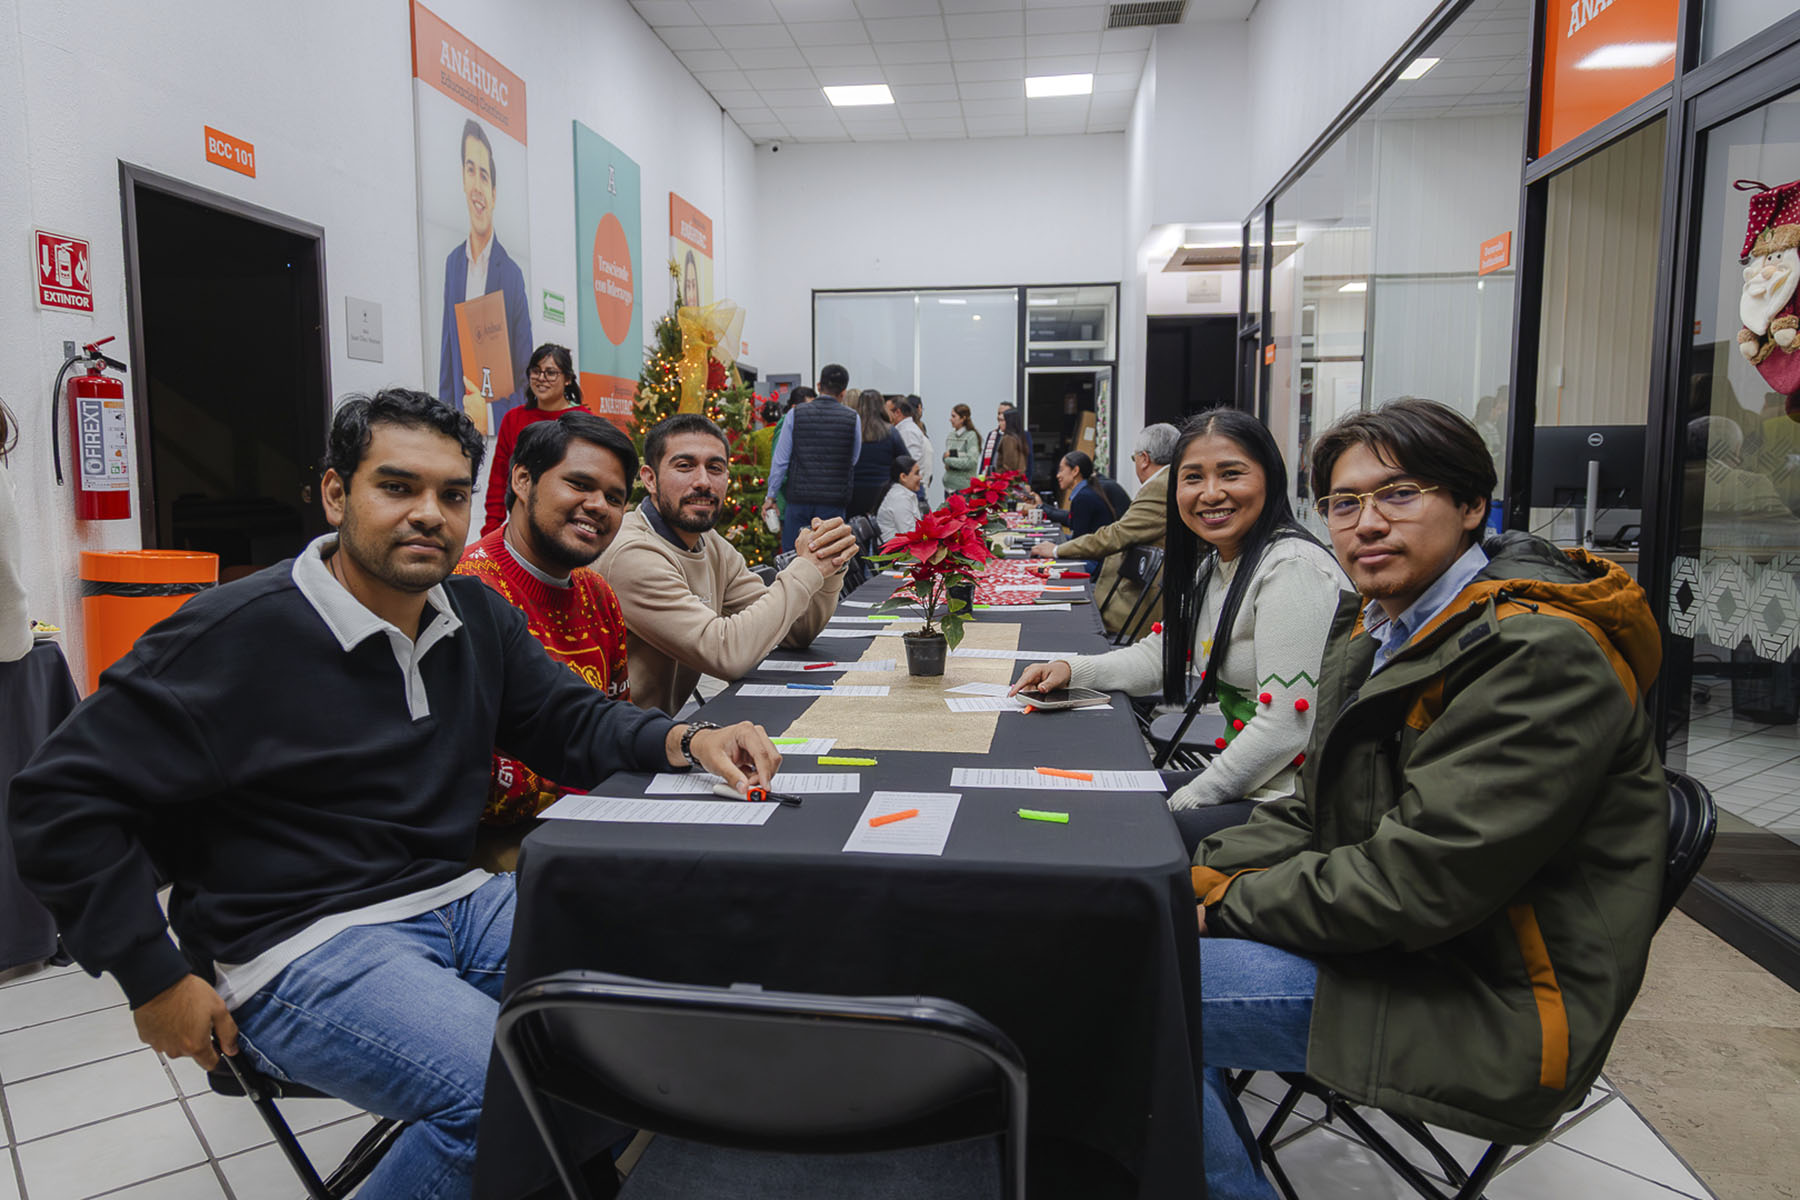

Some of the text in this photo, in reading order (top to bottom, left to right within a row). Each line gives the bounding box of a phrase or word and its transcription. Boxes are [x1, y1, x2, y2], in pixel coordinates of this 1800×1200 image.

[440, 39, 509, 107] ANÁHUAC
[208, 136, 253, 169] BCC 101
[43, 290, 90, 308] EXTINTOR
[480, 367, 494, 398] A
